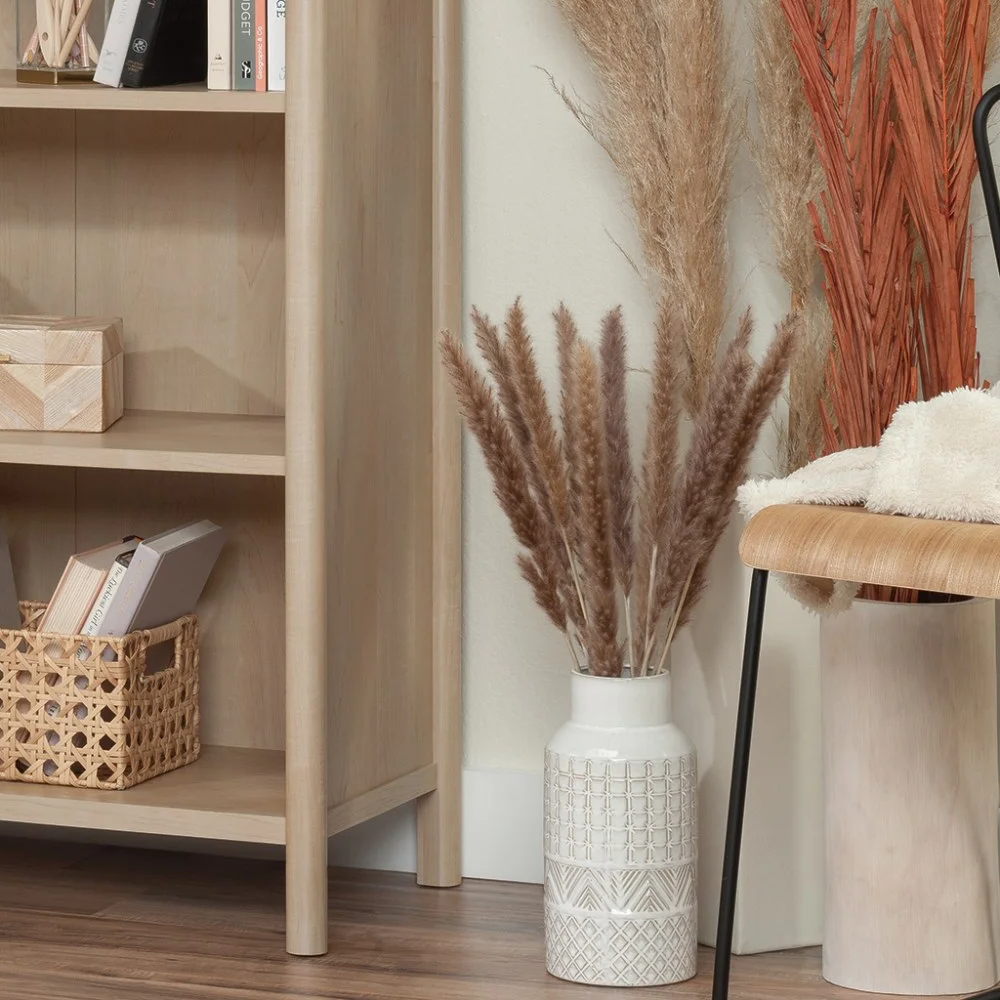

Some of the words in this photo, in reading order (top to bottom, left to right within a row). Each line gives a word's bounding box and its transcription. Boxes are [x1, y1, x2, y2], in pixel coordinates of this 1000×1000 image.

[256, 26, 263, 36] Co
[256, 44, 264, 80] Geographic
[114, 566, 123, 577] The
[101, 579, 118, 609] Luckiest
[91, 609, 103, 627] Girl
